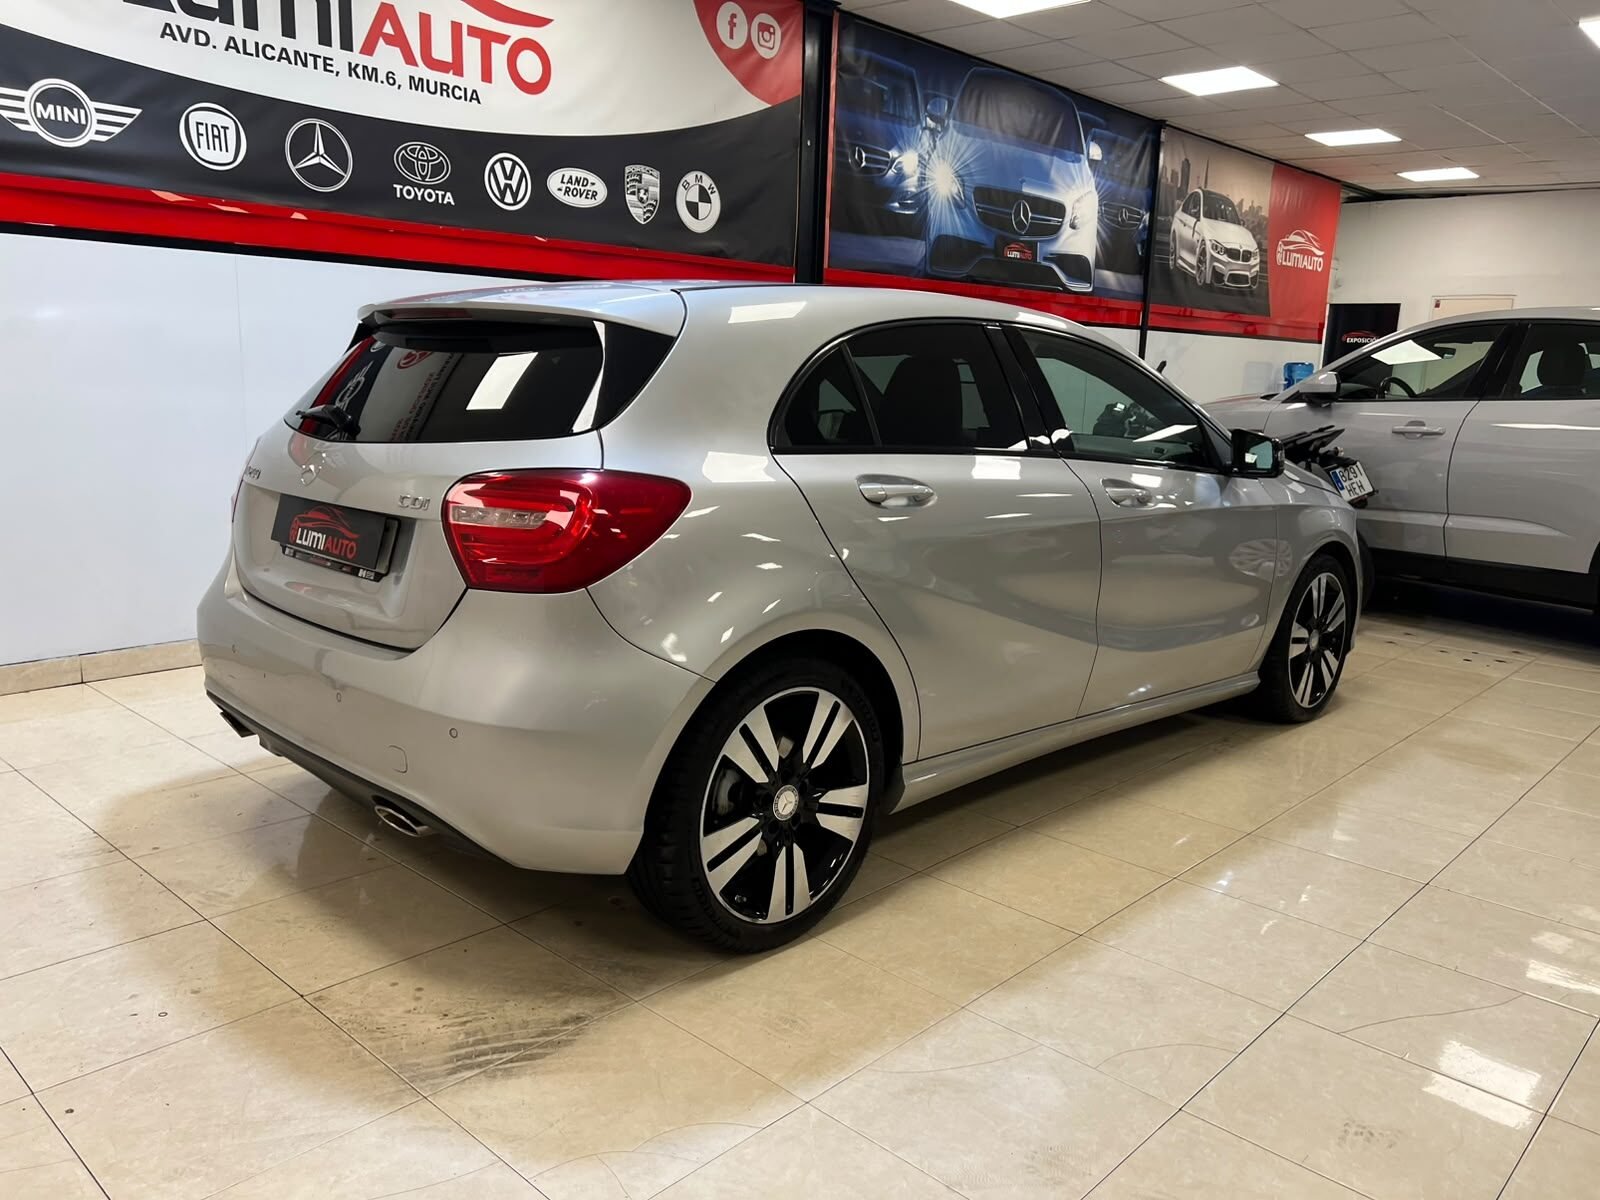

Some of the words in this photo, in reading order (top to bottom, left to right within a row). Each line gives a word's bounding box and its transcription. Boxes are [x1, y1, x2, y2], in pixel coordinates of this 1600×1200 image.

[160, 22, 217, 49] AVD.
[224, 36, 341, 77] ALICANTE,
[347, 61, 402, 90] KM.6,
[408, 75, 481, 104] MURCIA
[35, 102, 87, 125] MINI
[195, 121, 230, 153] FIAT
[393, 184, 455, 206] TOYOTA
[681, 174, 716, 195] BMW
[1346, 335, 1380, 344] EXPOSICIÓ
[1338, 464, 1363, 483] 8291
[1345, 480, 1366, 497] HEH
